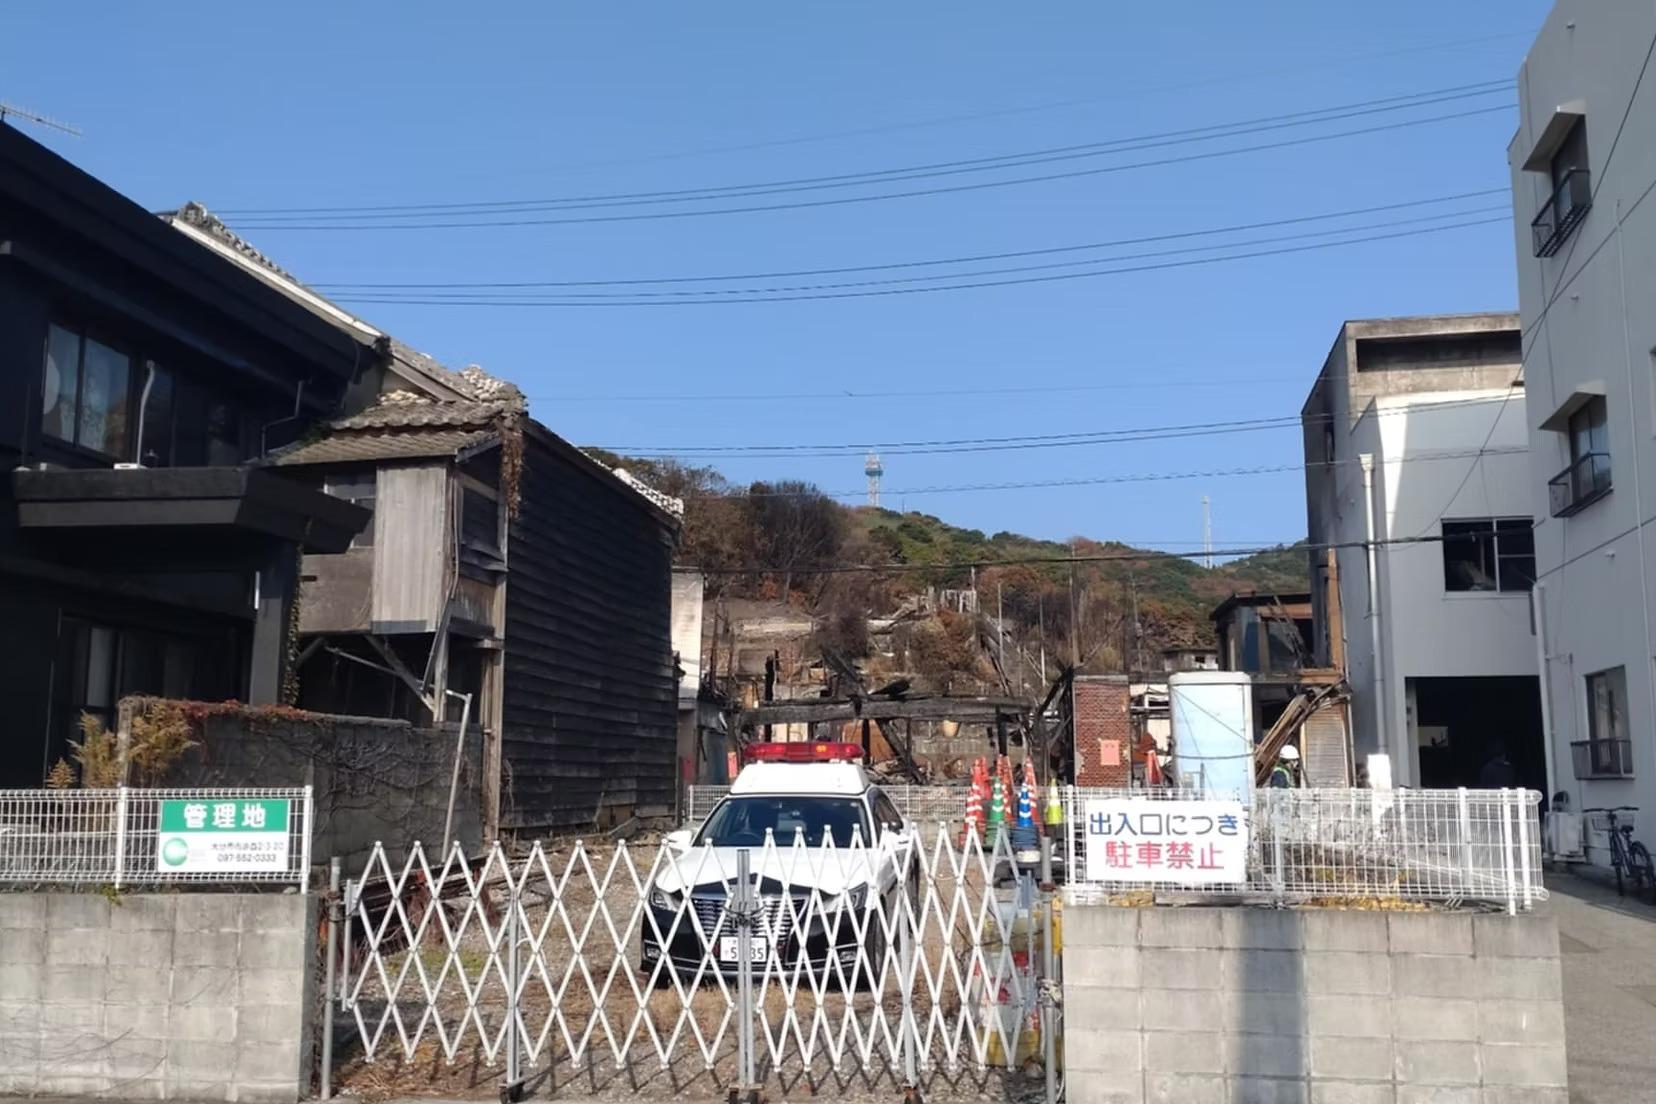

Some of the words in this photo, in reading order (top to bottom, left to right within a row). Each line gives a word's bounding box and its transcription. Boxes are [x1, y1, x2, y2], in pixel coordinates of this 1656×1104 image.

[184, 803, 266, 829] 管理地
[1089, 812, 1239, 836] 出入口につき
[1105, 840, 1225, 869] 駐車禁止
